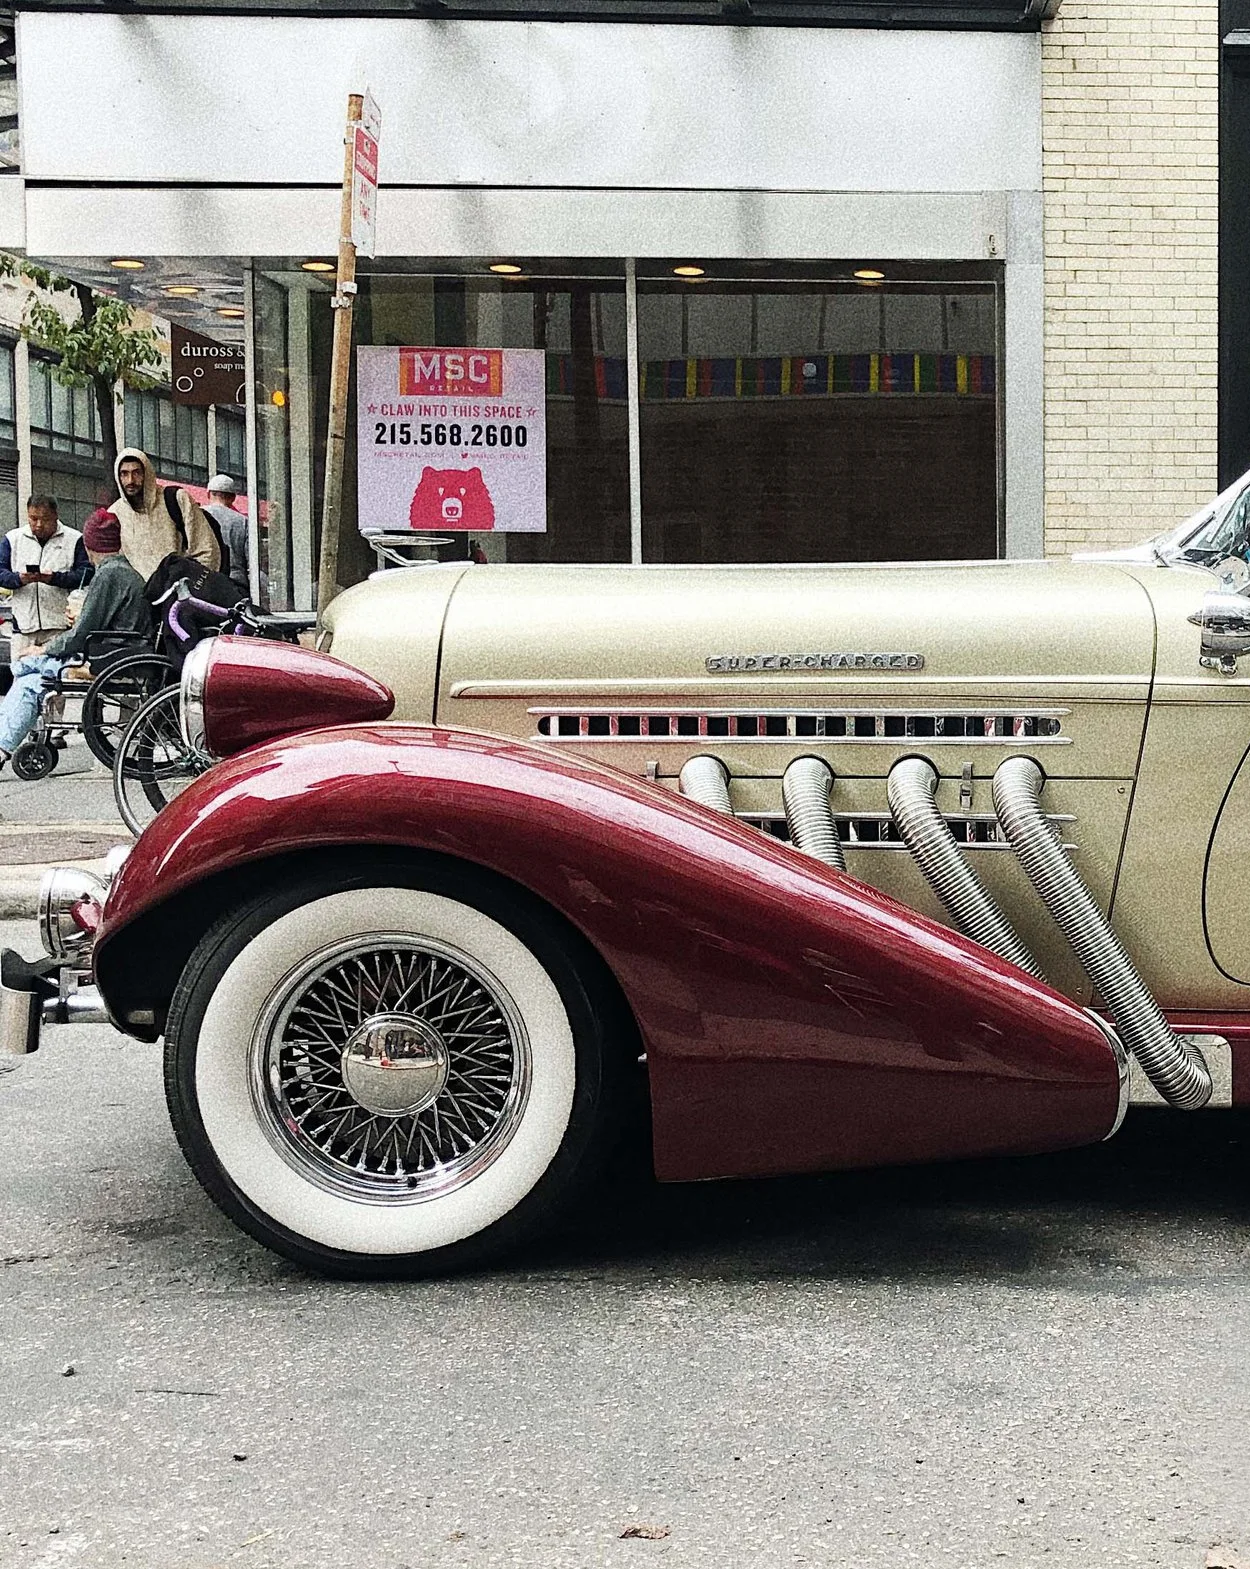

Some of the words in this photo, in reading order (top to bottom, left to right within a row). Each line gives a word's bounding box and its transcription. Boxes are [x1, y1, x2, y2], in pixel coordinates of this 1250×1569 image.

[181, 342, 233, 357] duross
[214, 362, 233, 372] soap
[414, 353, 488, 383] MSC
[429, 384, 474, 393] RETAIL
[381, 403, 414, 416] CLAW
[418, 404, 447, 417] INTO
[452, 405, 480, 418] THIS
[484, 405, 523, 419] SPACE
[375, 422, 528, 447] 215.568.2600
[708, 654, 921, 671] SUPER-CHARGED
